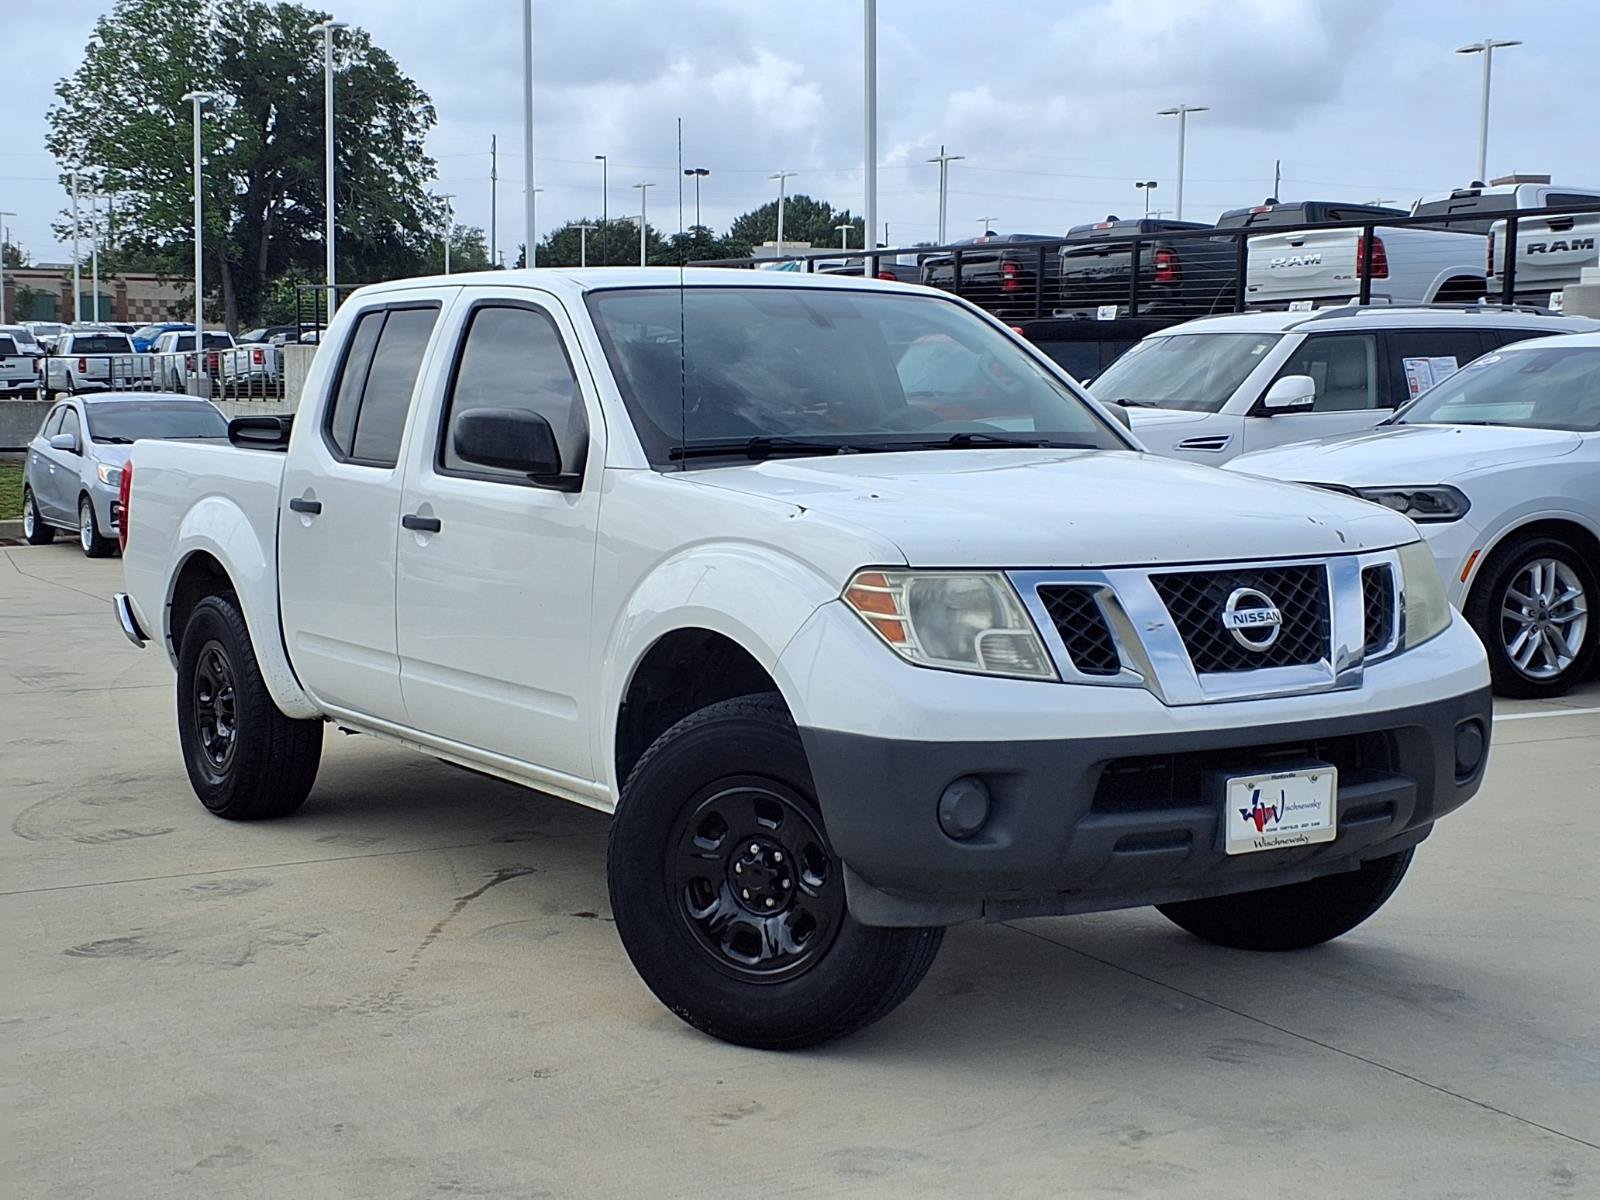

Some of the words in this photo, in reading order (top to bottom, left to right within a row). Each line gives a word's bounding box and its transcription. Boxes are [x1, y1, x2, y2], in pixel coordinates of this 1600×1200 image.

[1527, 238, 1594, 255] RAM
[1270, 254, 1322, 269] RAM
[1233, 612, 1280, 624] NISSAN
